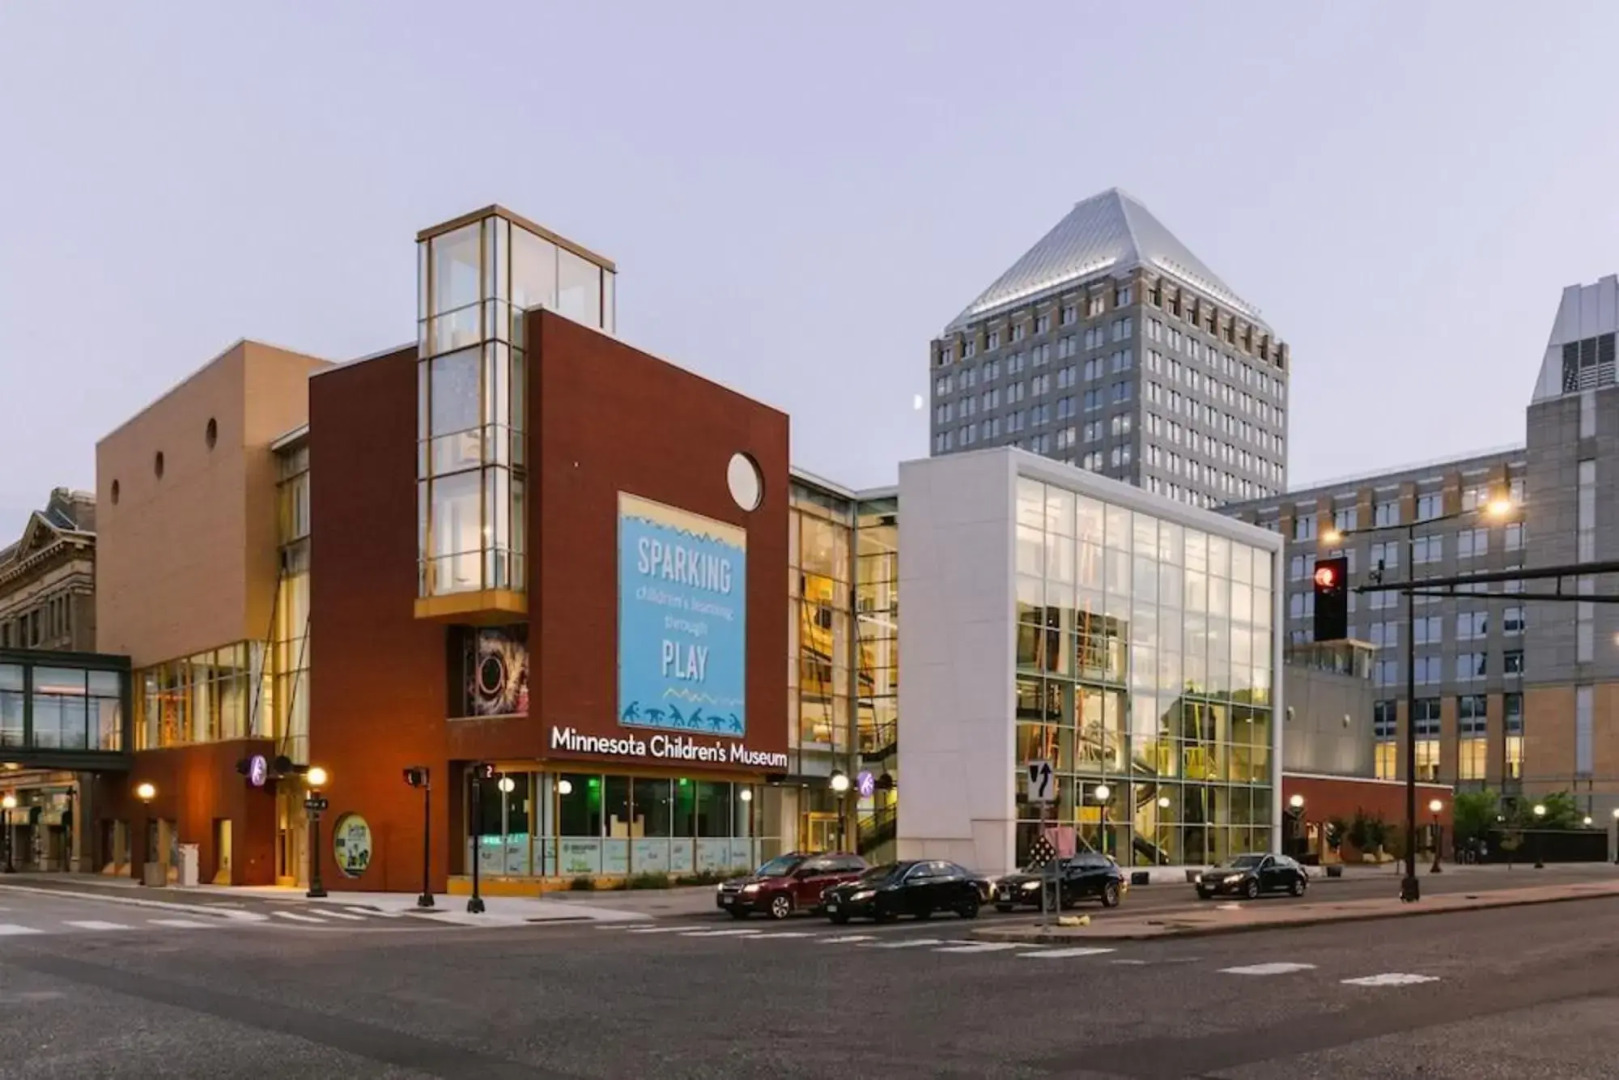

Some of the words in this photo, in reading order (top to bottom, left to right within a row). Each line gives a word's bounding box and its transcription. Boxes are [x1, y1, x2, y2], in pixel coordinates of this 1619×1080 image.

[637, 537, 731, 594] SPARKING
[662, 639, 709, 682] PLAY
[551, 725, 646, 756] Minnesota
[650, 734, 727, 762] Children's
[730, 743, 788, 768] Museum
